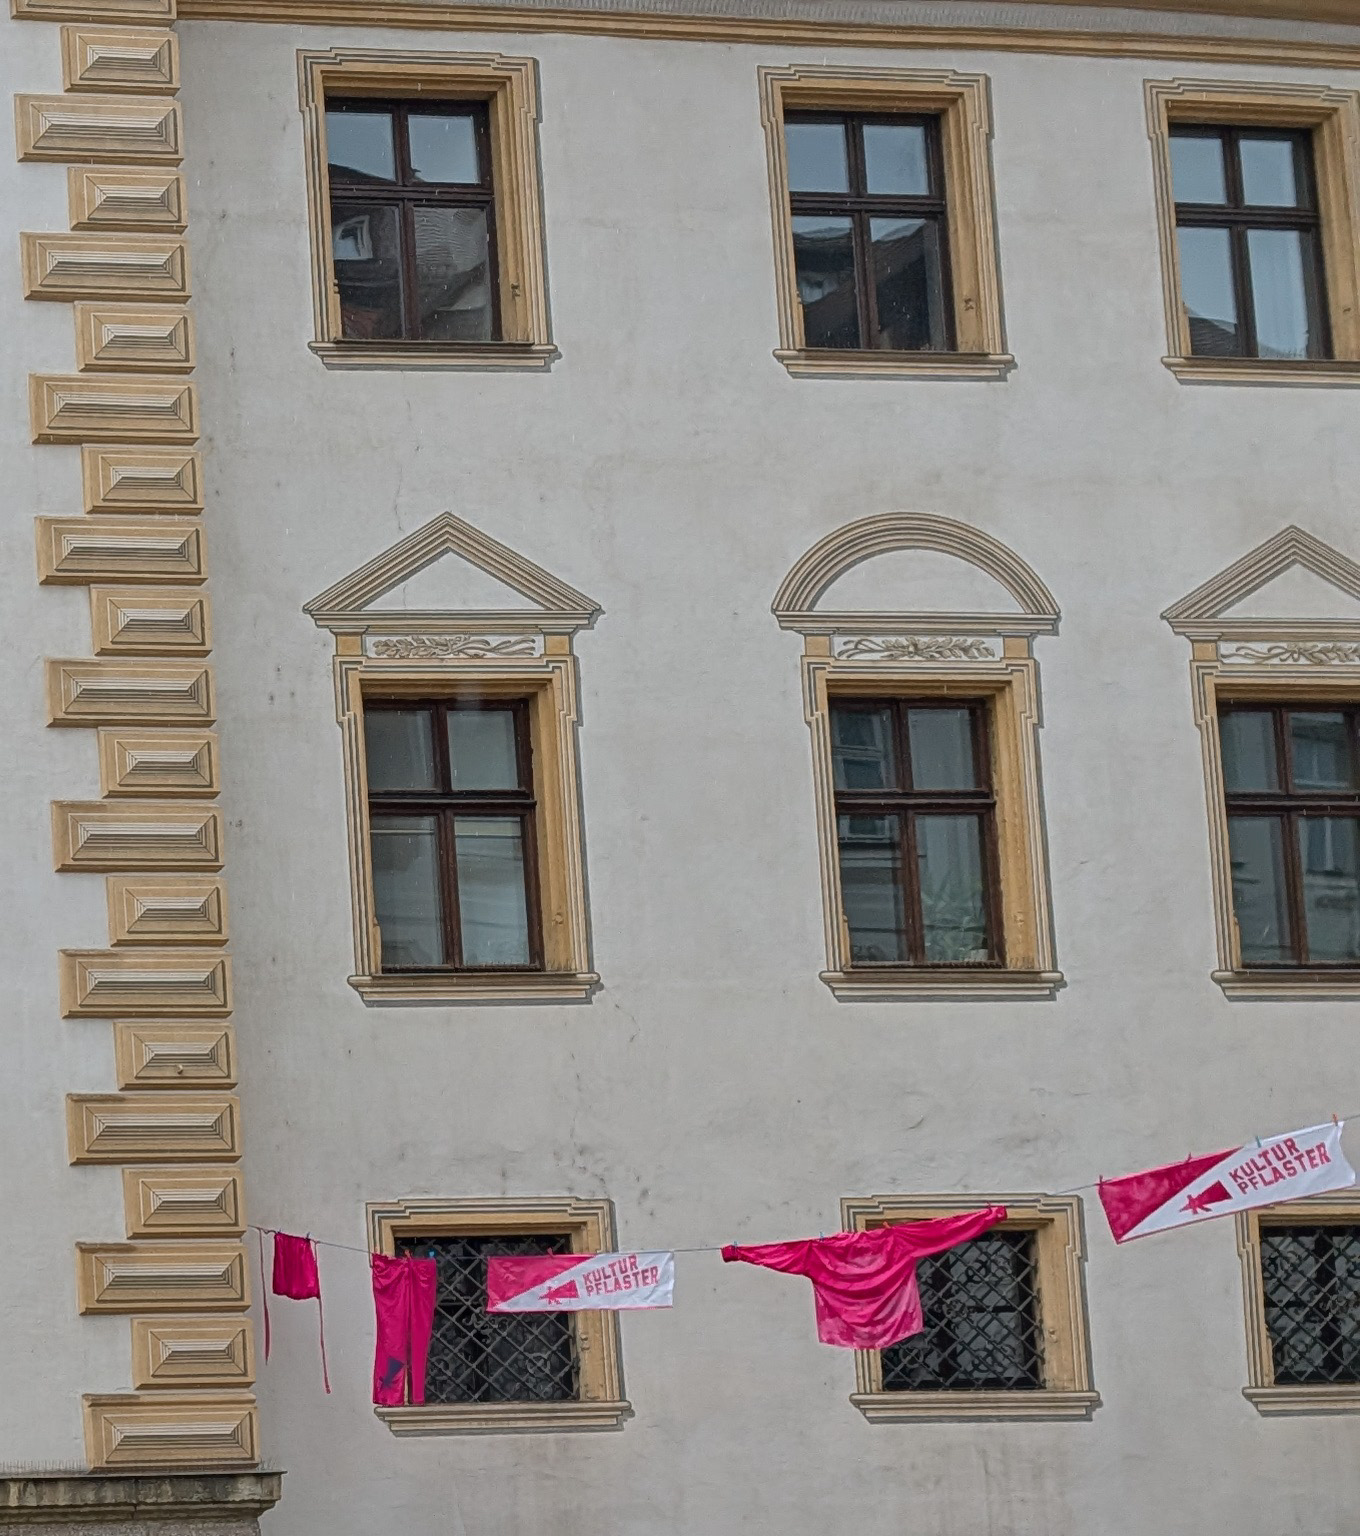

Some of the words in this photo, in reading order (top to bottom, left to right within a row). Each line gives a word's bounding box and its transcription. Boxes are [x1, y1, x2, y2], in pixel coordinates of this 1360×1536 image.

[1228, 1138, 1300, 1183] KULTUR
[1237, 1142, 1331, 1195] PFLASTER
[582, 1254, 639, 1286] KULTUR
[585, 1265, 659, 1296] PFLASTER
